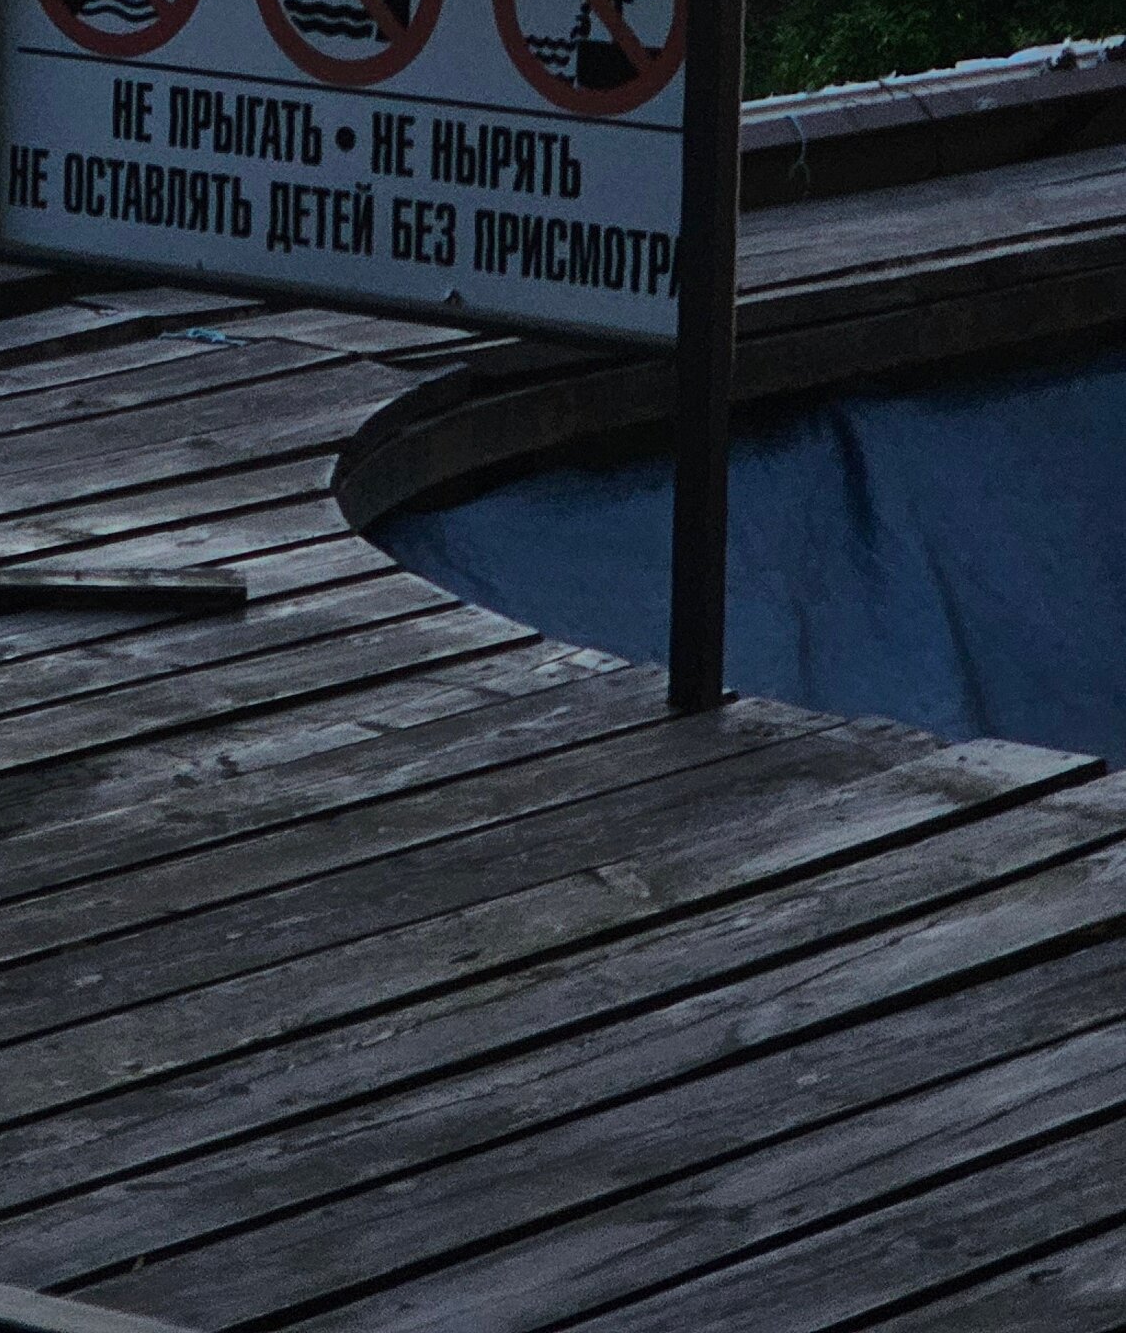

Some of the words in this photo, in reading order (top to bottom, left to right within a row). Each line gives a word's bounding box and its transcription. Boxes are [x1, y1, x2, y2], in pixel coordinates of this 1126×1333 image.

[112, 78, 153, 143] НЕ
[168, 85, 322, 166] ПРЫГАТЬ
[372, 111, 415, 178] НЕ
[431, 118, 581, 199] НЫРЯТЬ
[8, 145, 50, 210] НЕ
[64, 152, 252, 238] ОСТАВЛЯТЬ
[266, 180, 374, 256] ДЕТЕЙ
[391, 197, 456, 267] БЕЗ
